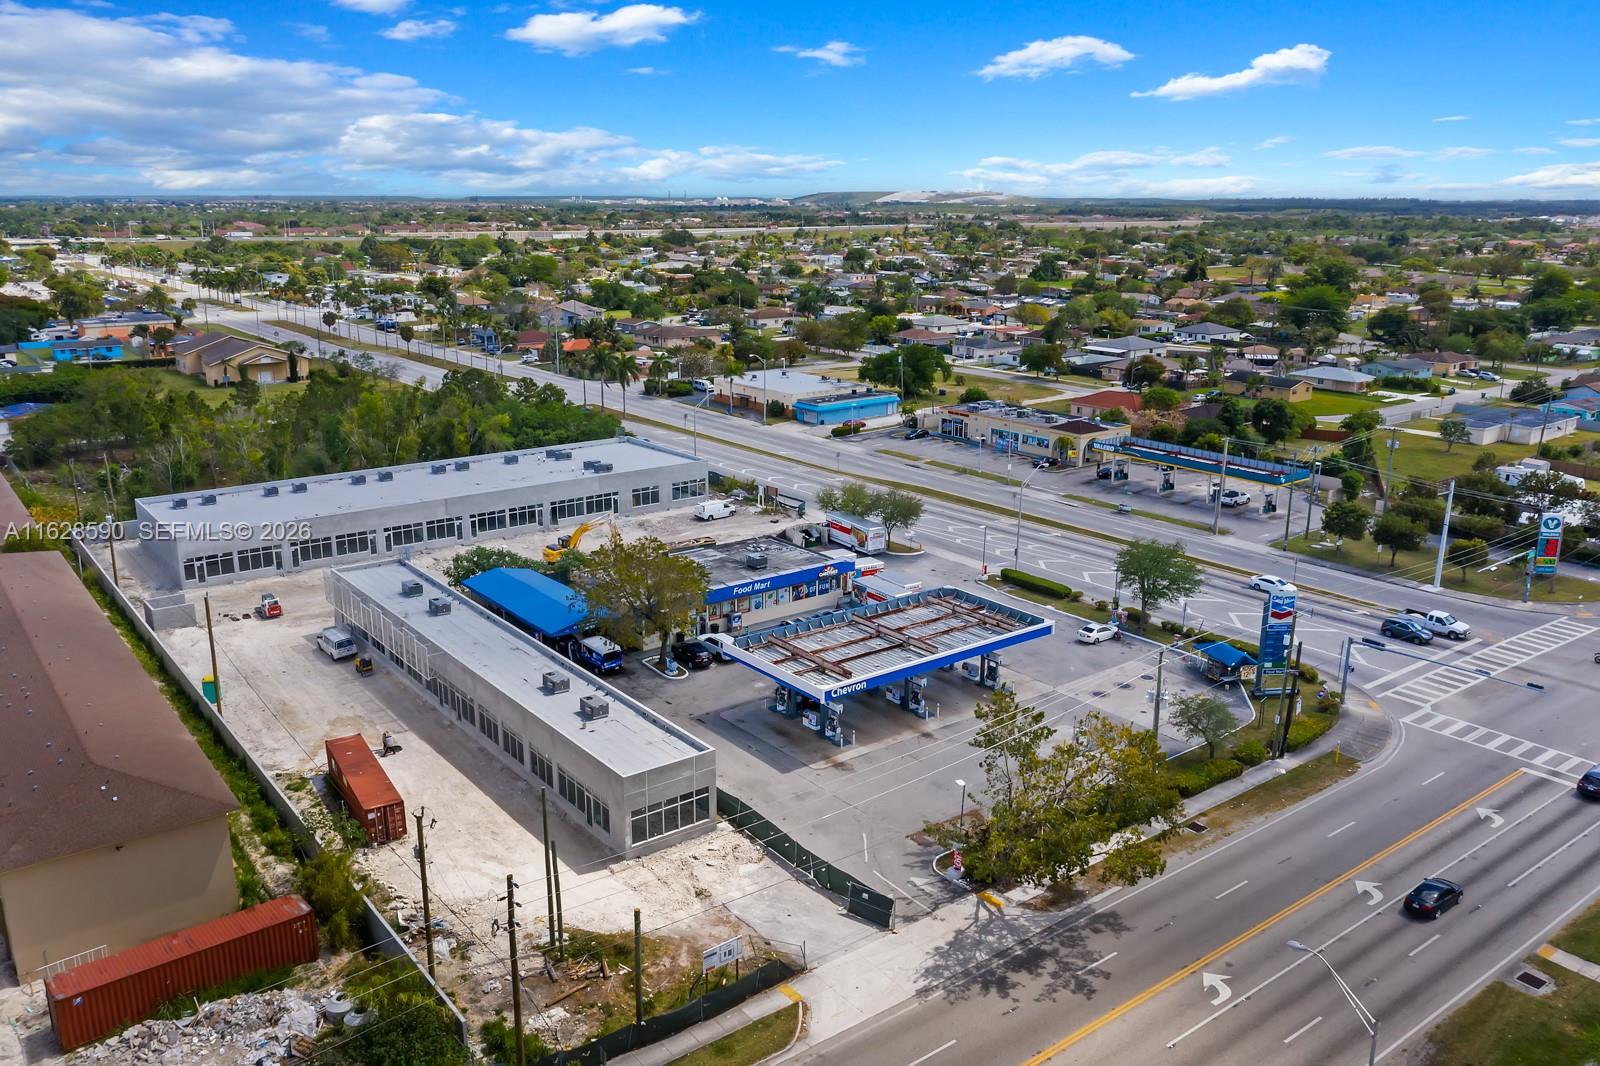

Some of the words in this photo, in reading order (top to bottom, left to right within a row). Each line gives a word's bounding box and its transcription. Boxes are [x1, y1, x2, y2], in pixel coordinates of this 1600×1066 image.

[733, 584, 752, 596] Food
[753, 581, 771, 591] Mart
[831, 681, 867, 697] Chevron
